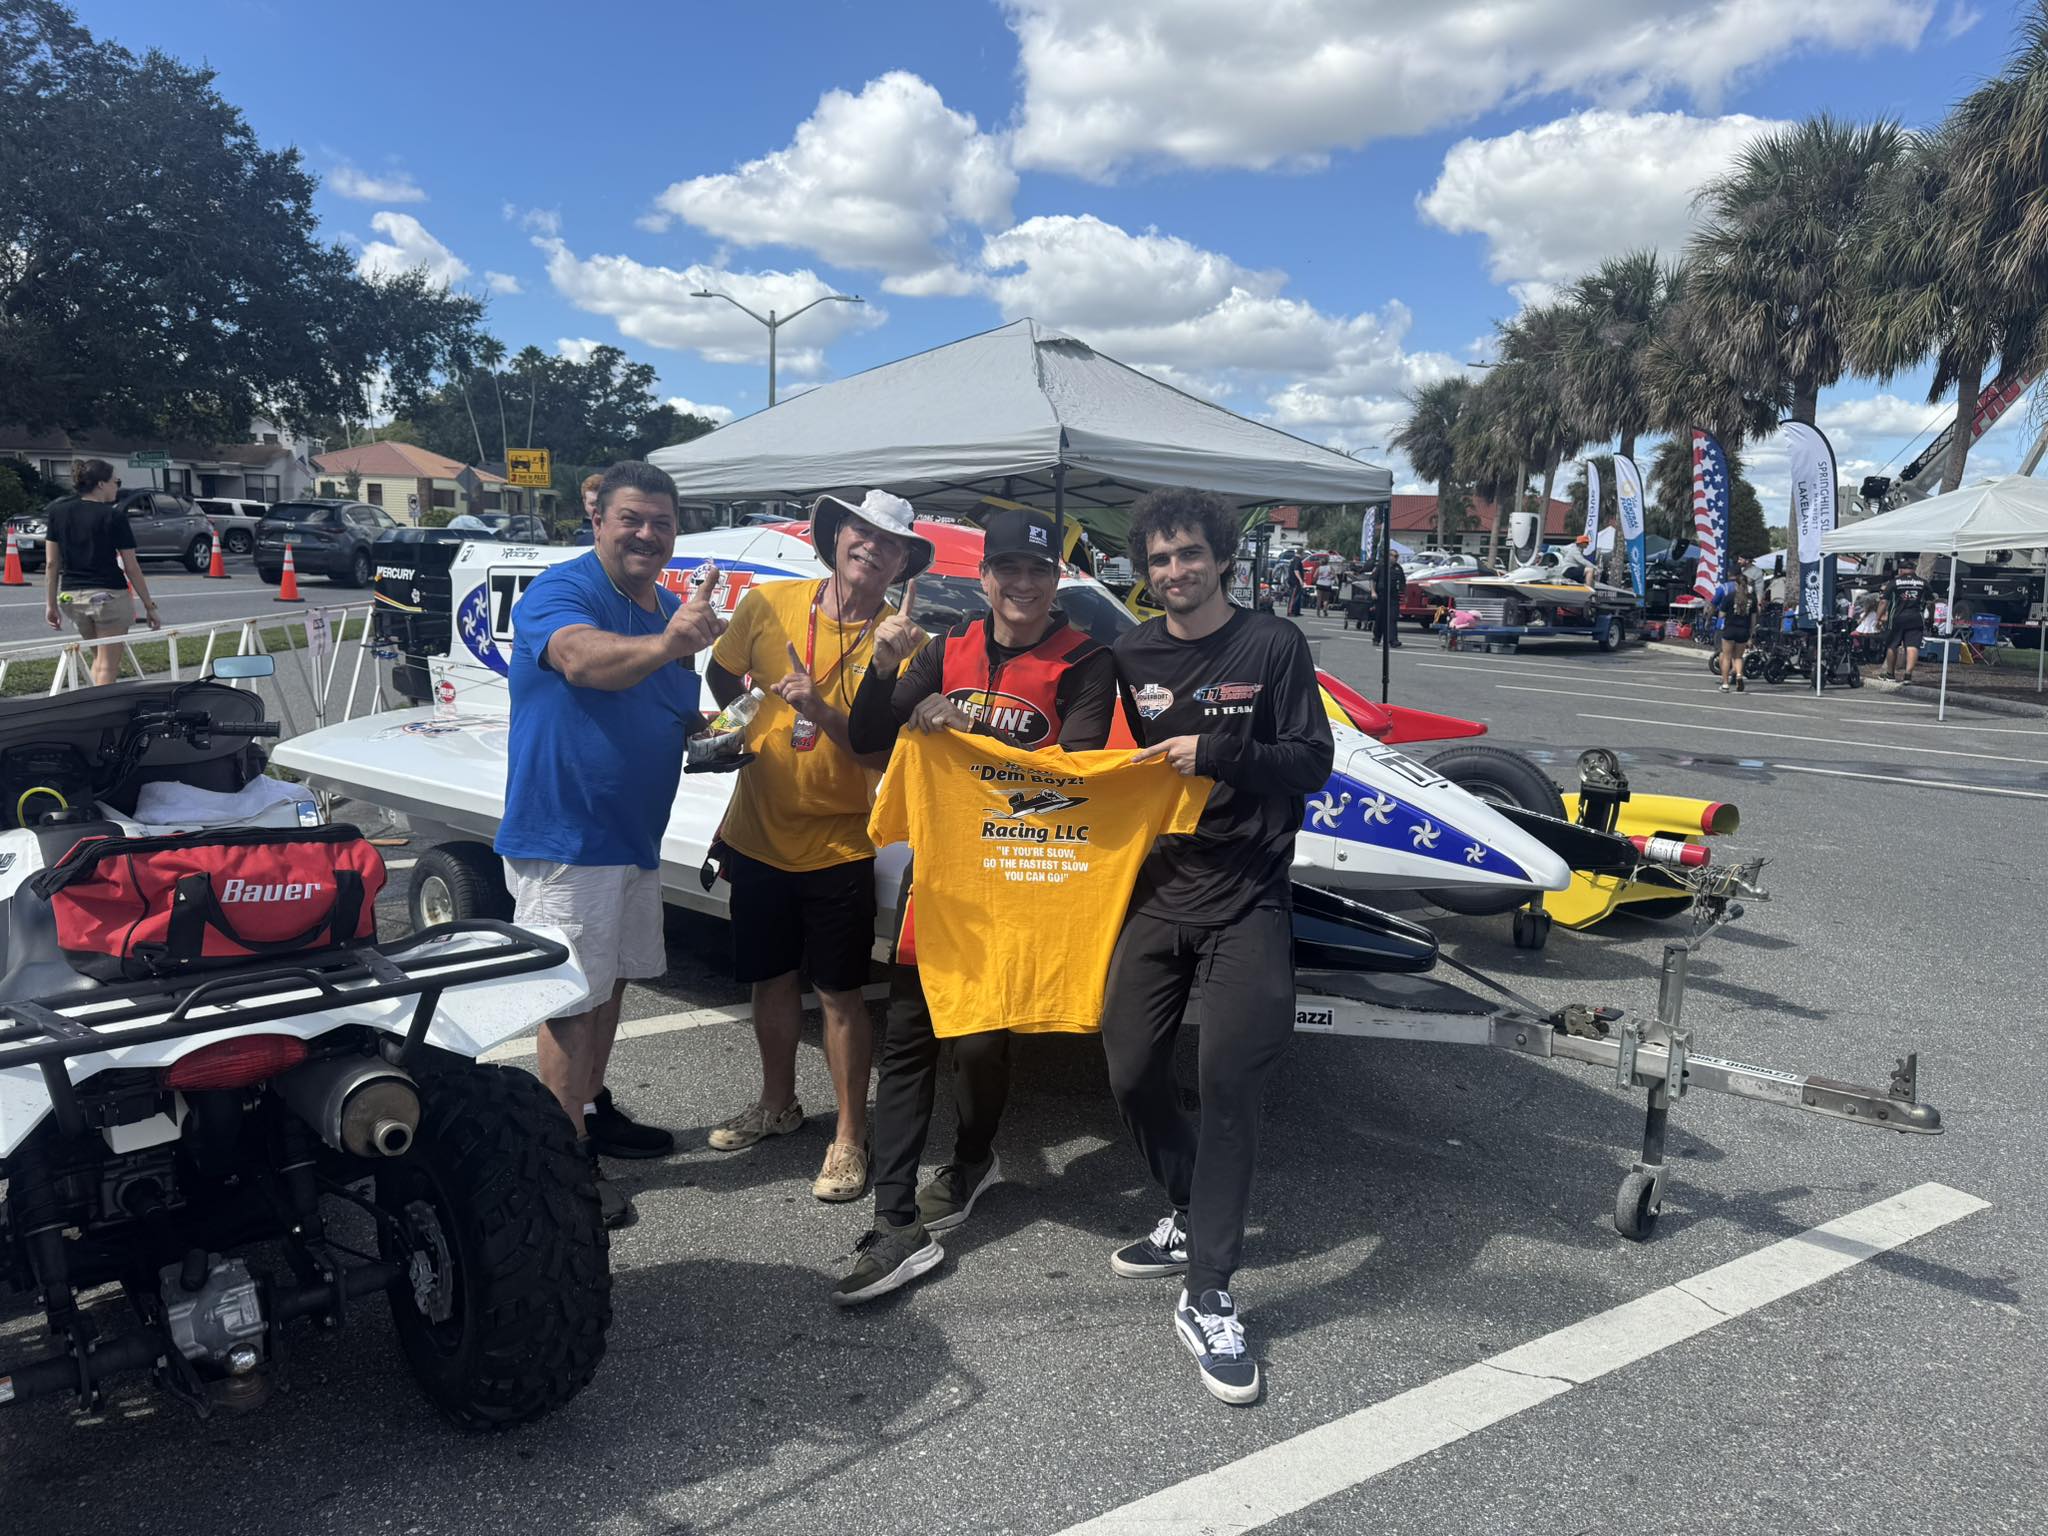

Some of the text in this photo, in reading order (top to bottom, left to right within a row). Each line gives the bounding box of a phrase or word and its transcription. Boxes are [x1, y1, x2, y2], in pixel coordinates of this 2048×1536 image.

[1817, 461, 1830, 517] SPRINGHILL
[1797, 481, 1809, 535] LAKELAND
[376, 566, 416, 581] MERCURY
[1221, 705, 1253, 715] TEAM
[981, 822, 1090, 844] Racing LLC
[996, 846, 1077, 861] "IF YOU'RE SLOW,
[983, 858, 1089, 872] GO THE FASTEST SLOW
[1005, 871, 1024, 881] YOU
[1026, 872, 1046, 882] CAN
[220, 879, 321, 903] Bauer
[1688, 1052, 1797, 1080] MIKE QUINDAZZI
